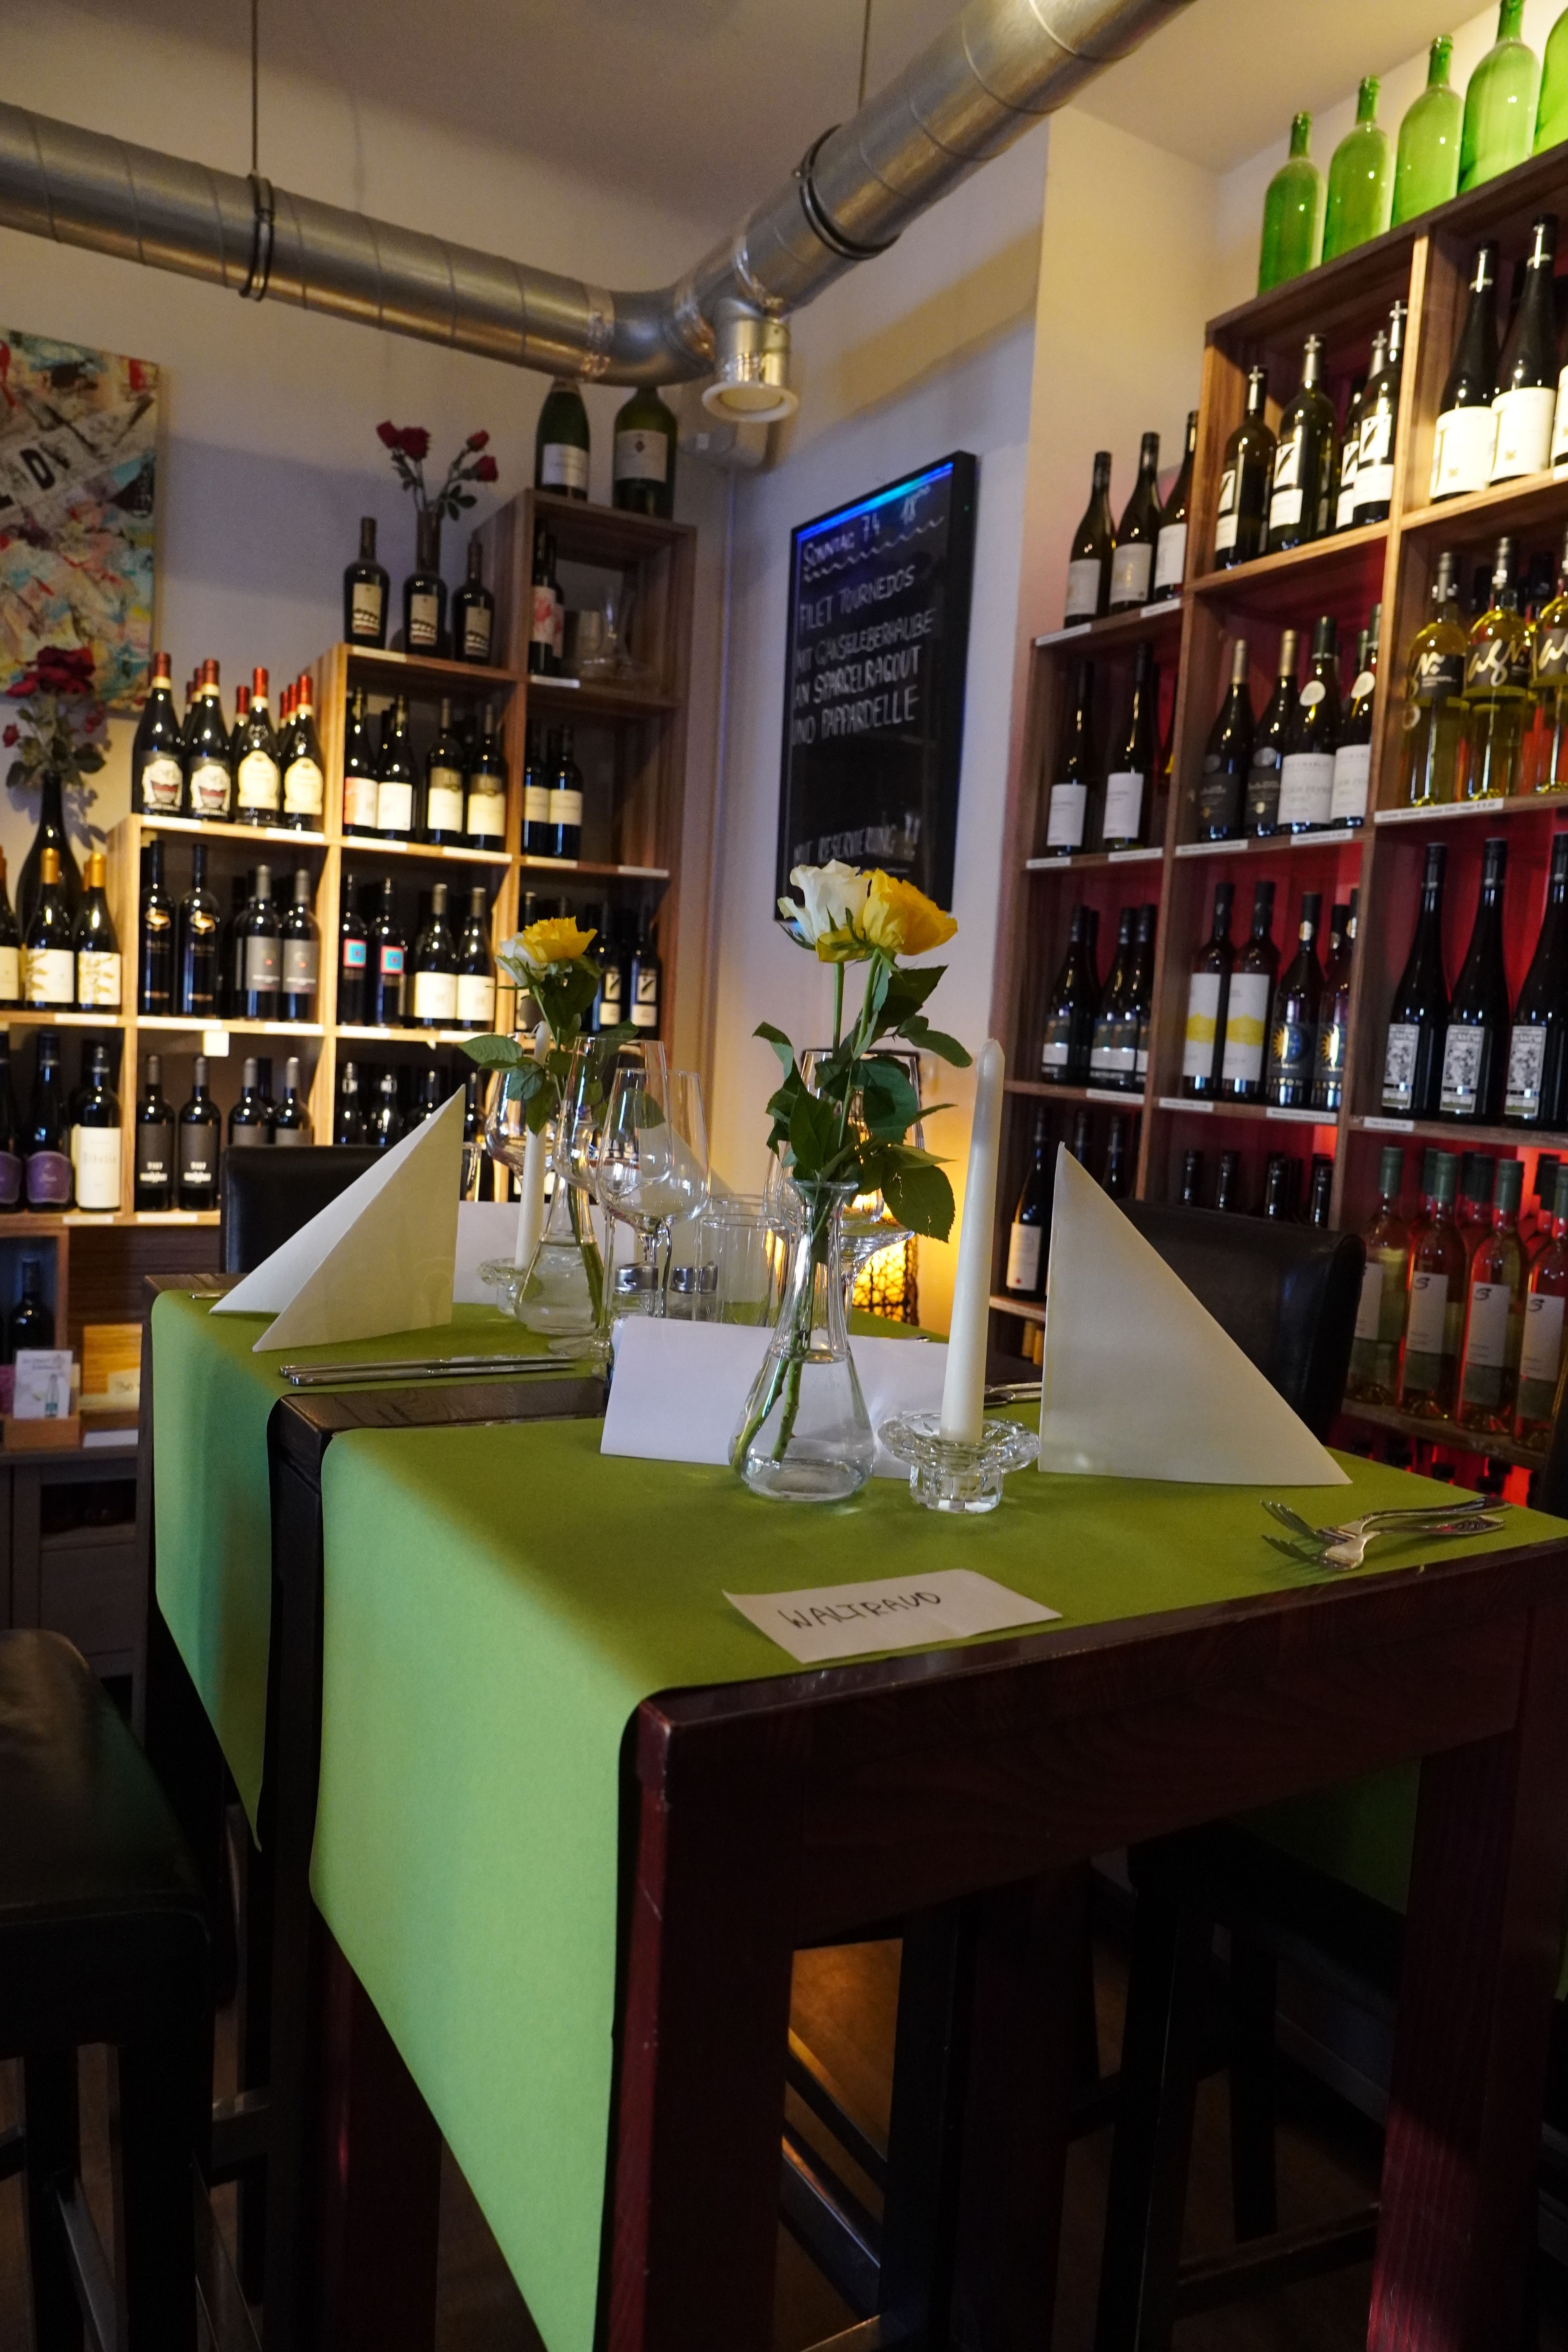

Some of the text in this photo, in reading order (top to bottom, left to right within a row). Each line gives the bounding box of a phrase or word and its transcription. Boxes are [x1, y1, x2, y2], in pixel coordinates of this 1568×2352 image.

[800, 564, 916, 634] FILET TOURNEDOS
[778, 1592, 941, 1629] WALTRAUD
